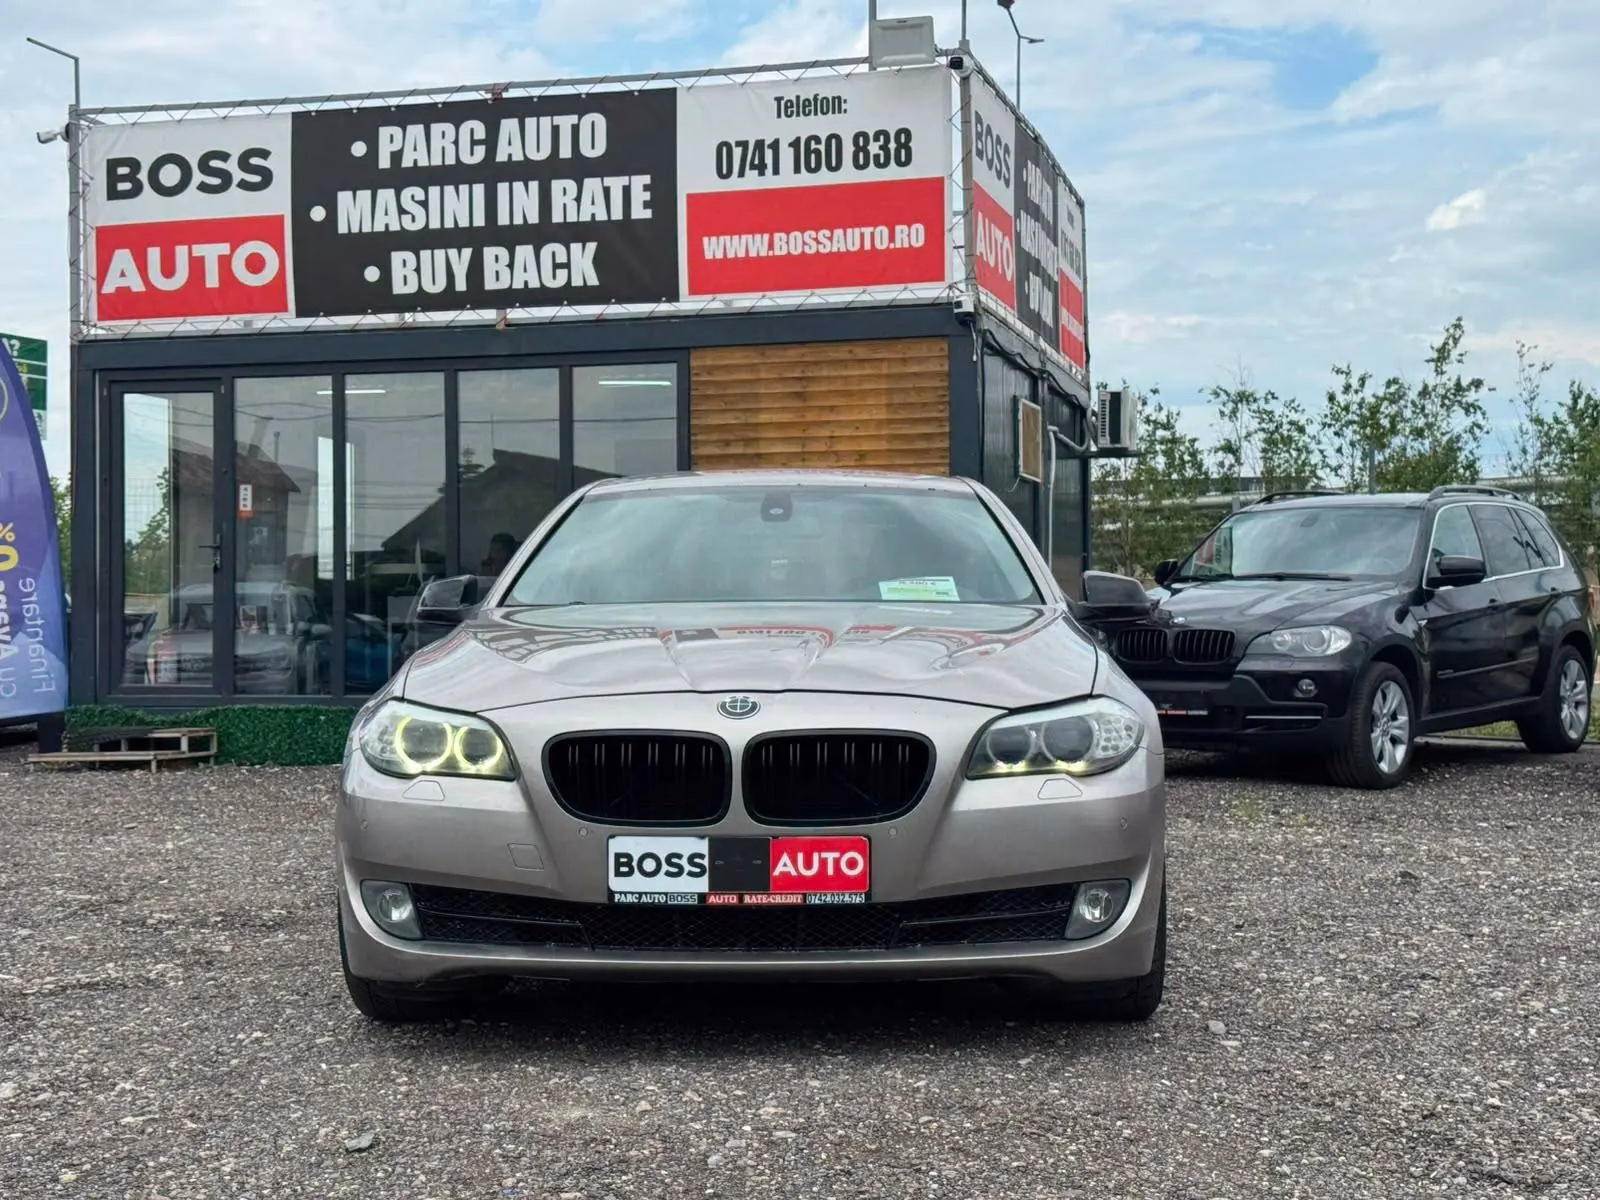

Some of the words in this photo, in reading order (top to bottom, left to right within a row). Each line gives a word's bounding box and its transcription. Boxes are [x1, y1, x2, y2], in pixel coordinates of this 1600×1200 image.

[774, 93, 848, 119] Telefon:
[378, 119, 486, 169] PARC
[495, 112, 607, 163] AUTO
[715, 137, 780, 180] 0741
[787, 132, 844, 175] 160
[852, 127, 913, 171] 838
[974, 109, 1010, 190] BOSS
[106, 147, 274, 202] BOSS
[337, 183, 486, 234] MASINI
[497, 180, 540, 226] IN
[551, 174, 653, 224] RATE
[101, 240, 280, 294] AUTO
[390, 247, 473, 295] BUY
[483, 241, 600, 291] BACK
[702, 223, 925, 260] WWW.BOSSAUTO.RO
[976, 210, 1013, 282] AUTO
[613, 850, 708, 879] BOSS
[772, 850, 865, 877] AUTO
[614, 893, 639, 903] PARC
[640, 893, 666, 903] AUTO
[669, 894, 697, 903] BOSS
[708, 895, 738, 904] AUTO
